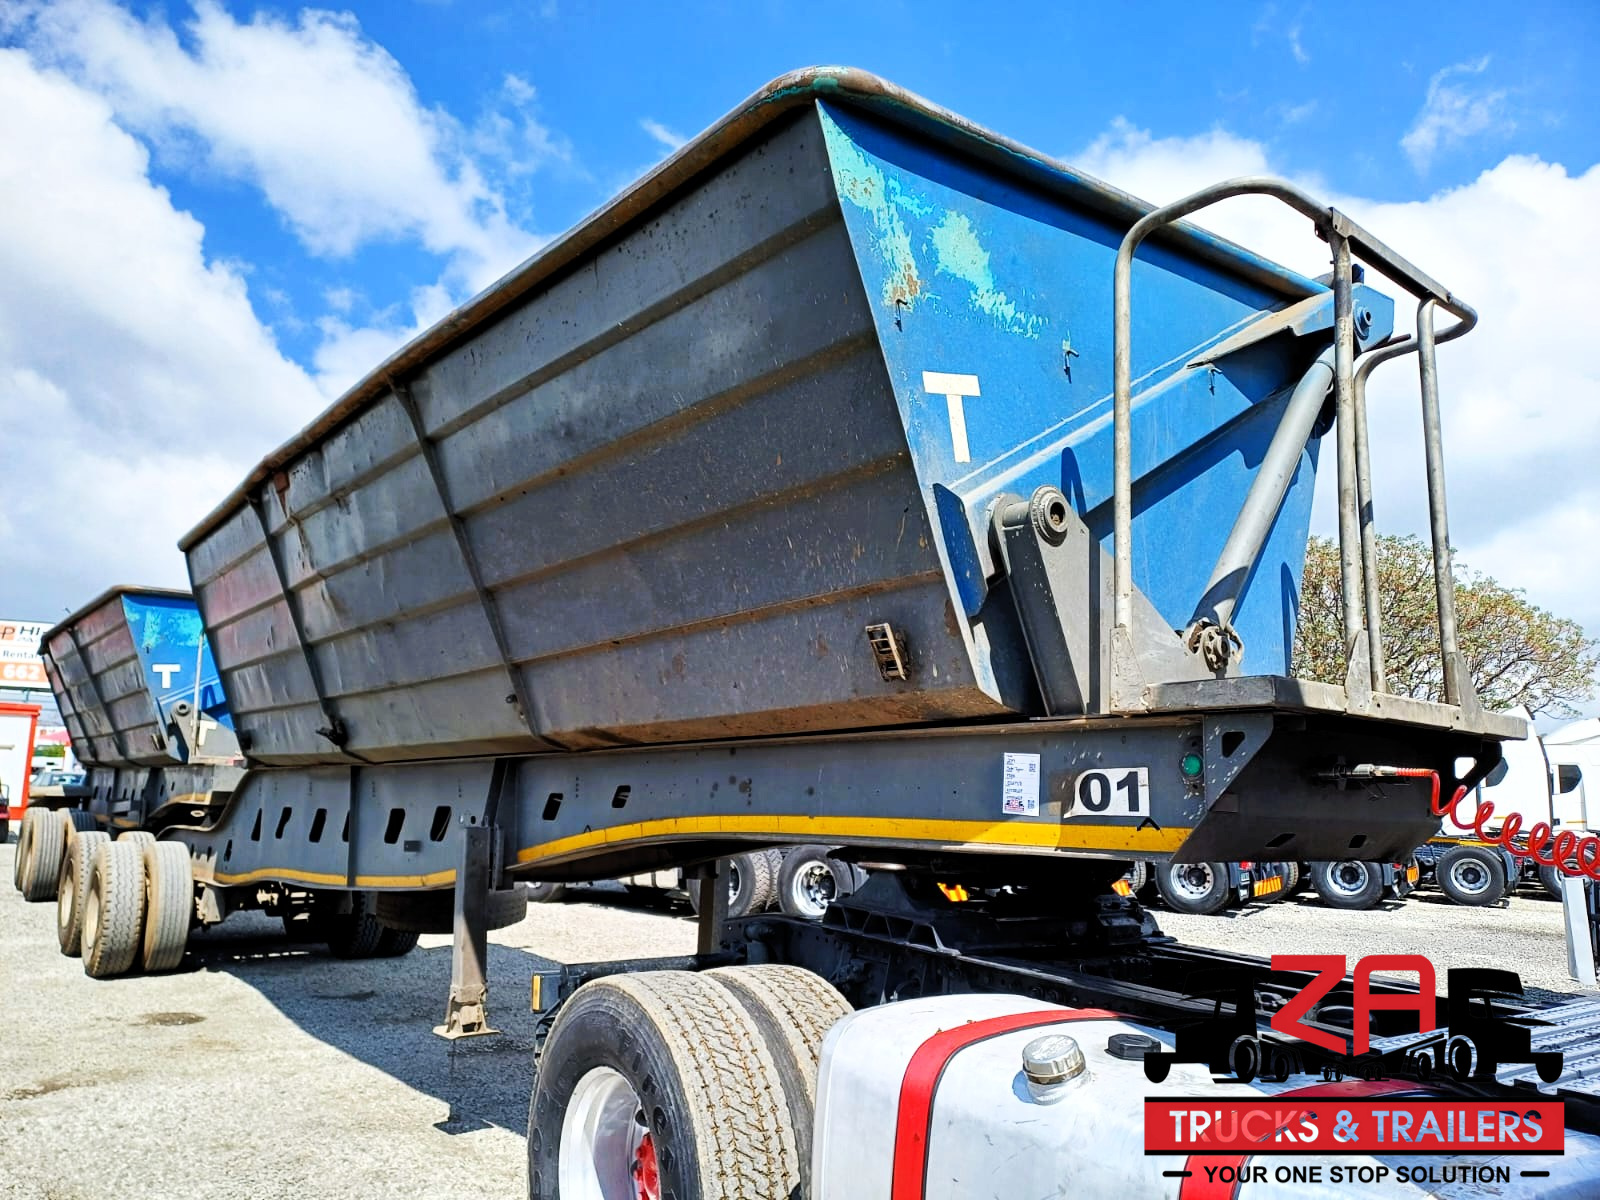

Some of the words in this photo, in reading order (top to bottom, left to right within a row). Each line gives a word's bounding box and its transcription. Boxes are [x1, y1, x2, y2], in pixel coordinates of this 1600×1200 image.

[922, 371, 981, 463] T
[152, 664, 180, 689] T
[1079, 771, 1140, 812] 01
